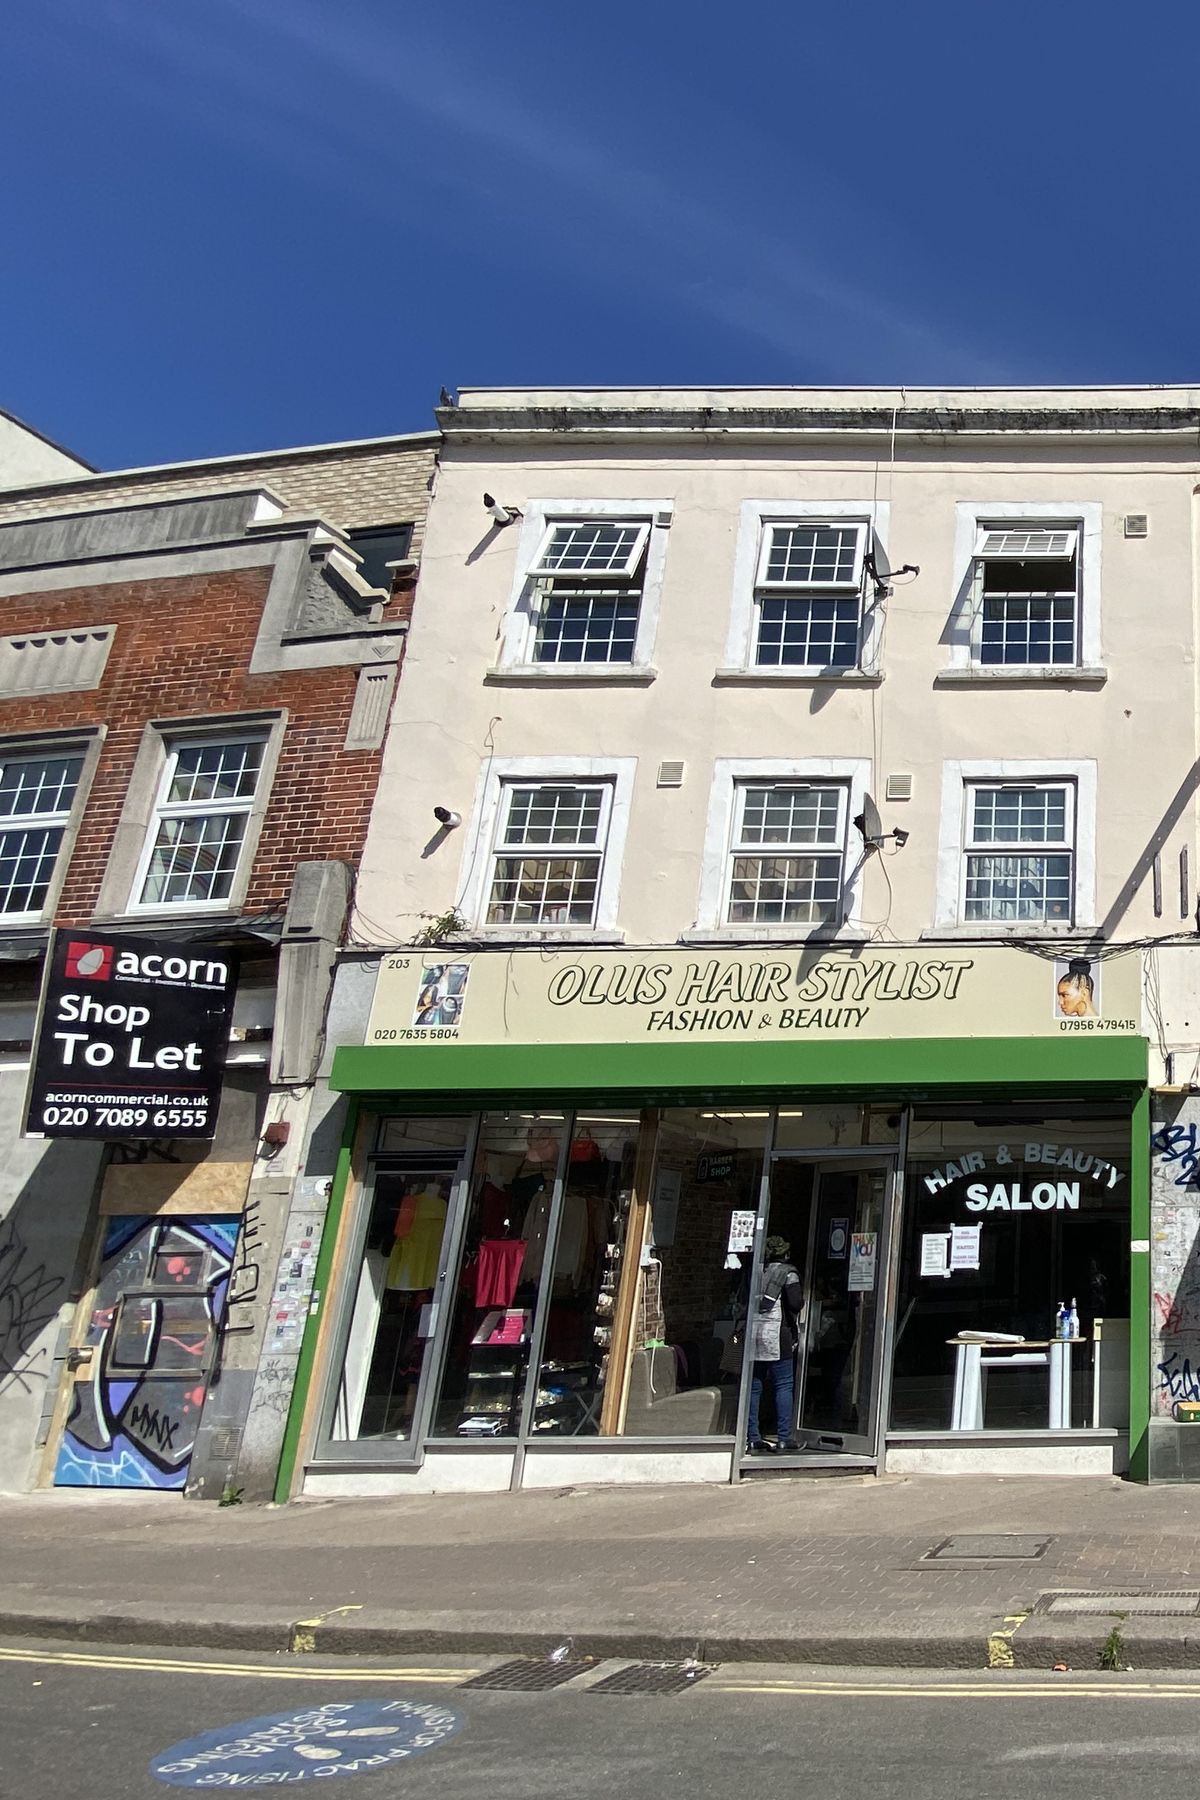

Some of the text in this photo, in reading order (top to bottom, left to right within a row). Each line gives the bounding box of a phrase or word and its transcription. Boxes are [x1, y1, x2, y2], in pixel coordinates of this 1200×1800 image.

[116, 951, 228, 984] acorn
[388, 959, 410, 969] 203
[547, 959, 975, 1006] OLUS HAIR STYLIST
[57, 994, 150, 1032] Shop
[646, 1006, 870, 1032] FASHION & BEAUTY
[1059, 1018, 1137, 1031] 07956 479415
[374, 1029, 459, 1040] 020 7635 5804
[54, 1032, 202, 1071] To Let
[46, 1092, 209, 1106] acorncommercial.co.uk
[43, 1107, 207, 1127] 020 7089 6555
[924, 1142, 1127, 1195] HAIR & BEAUTY
[965, 1182, 1080, 1211] SALON
